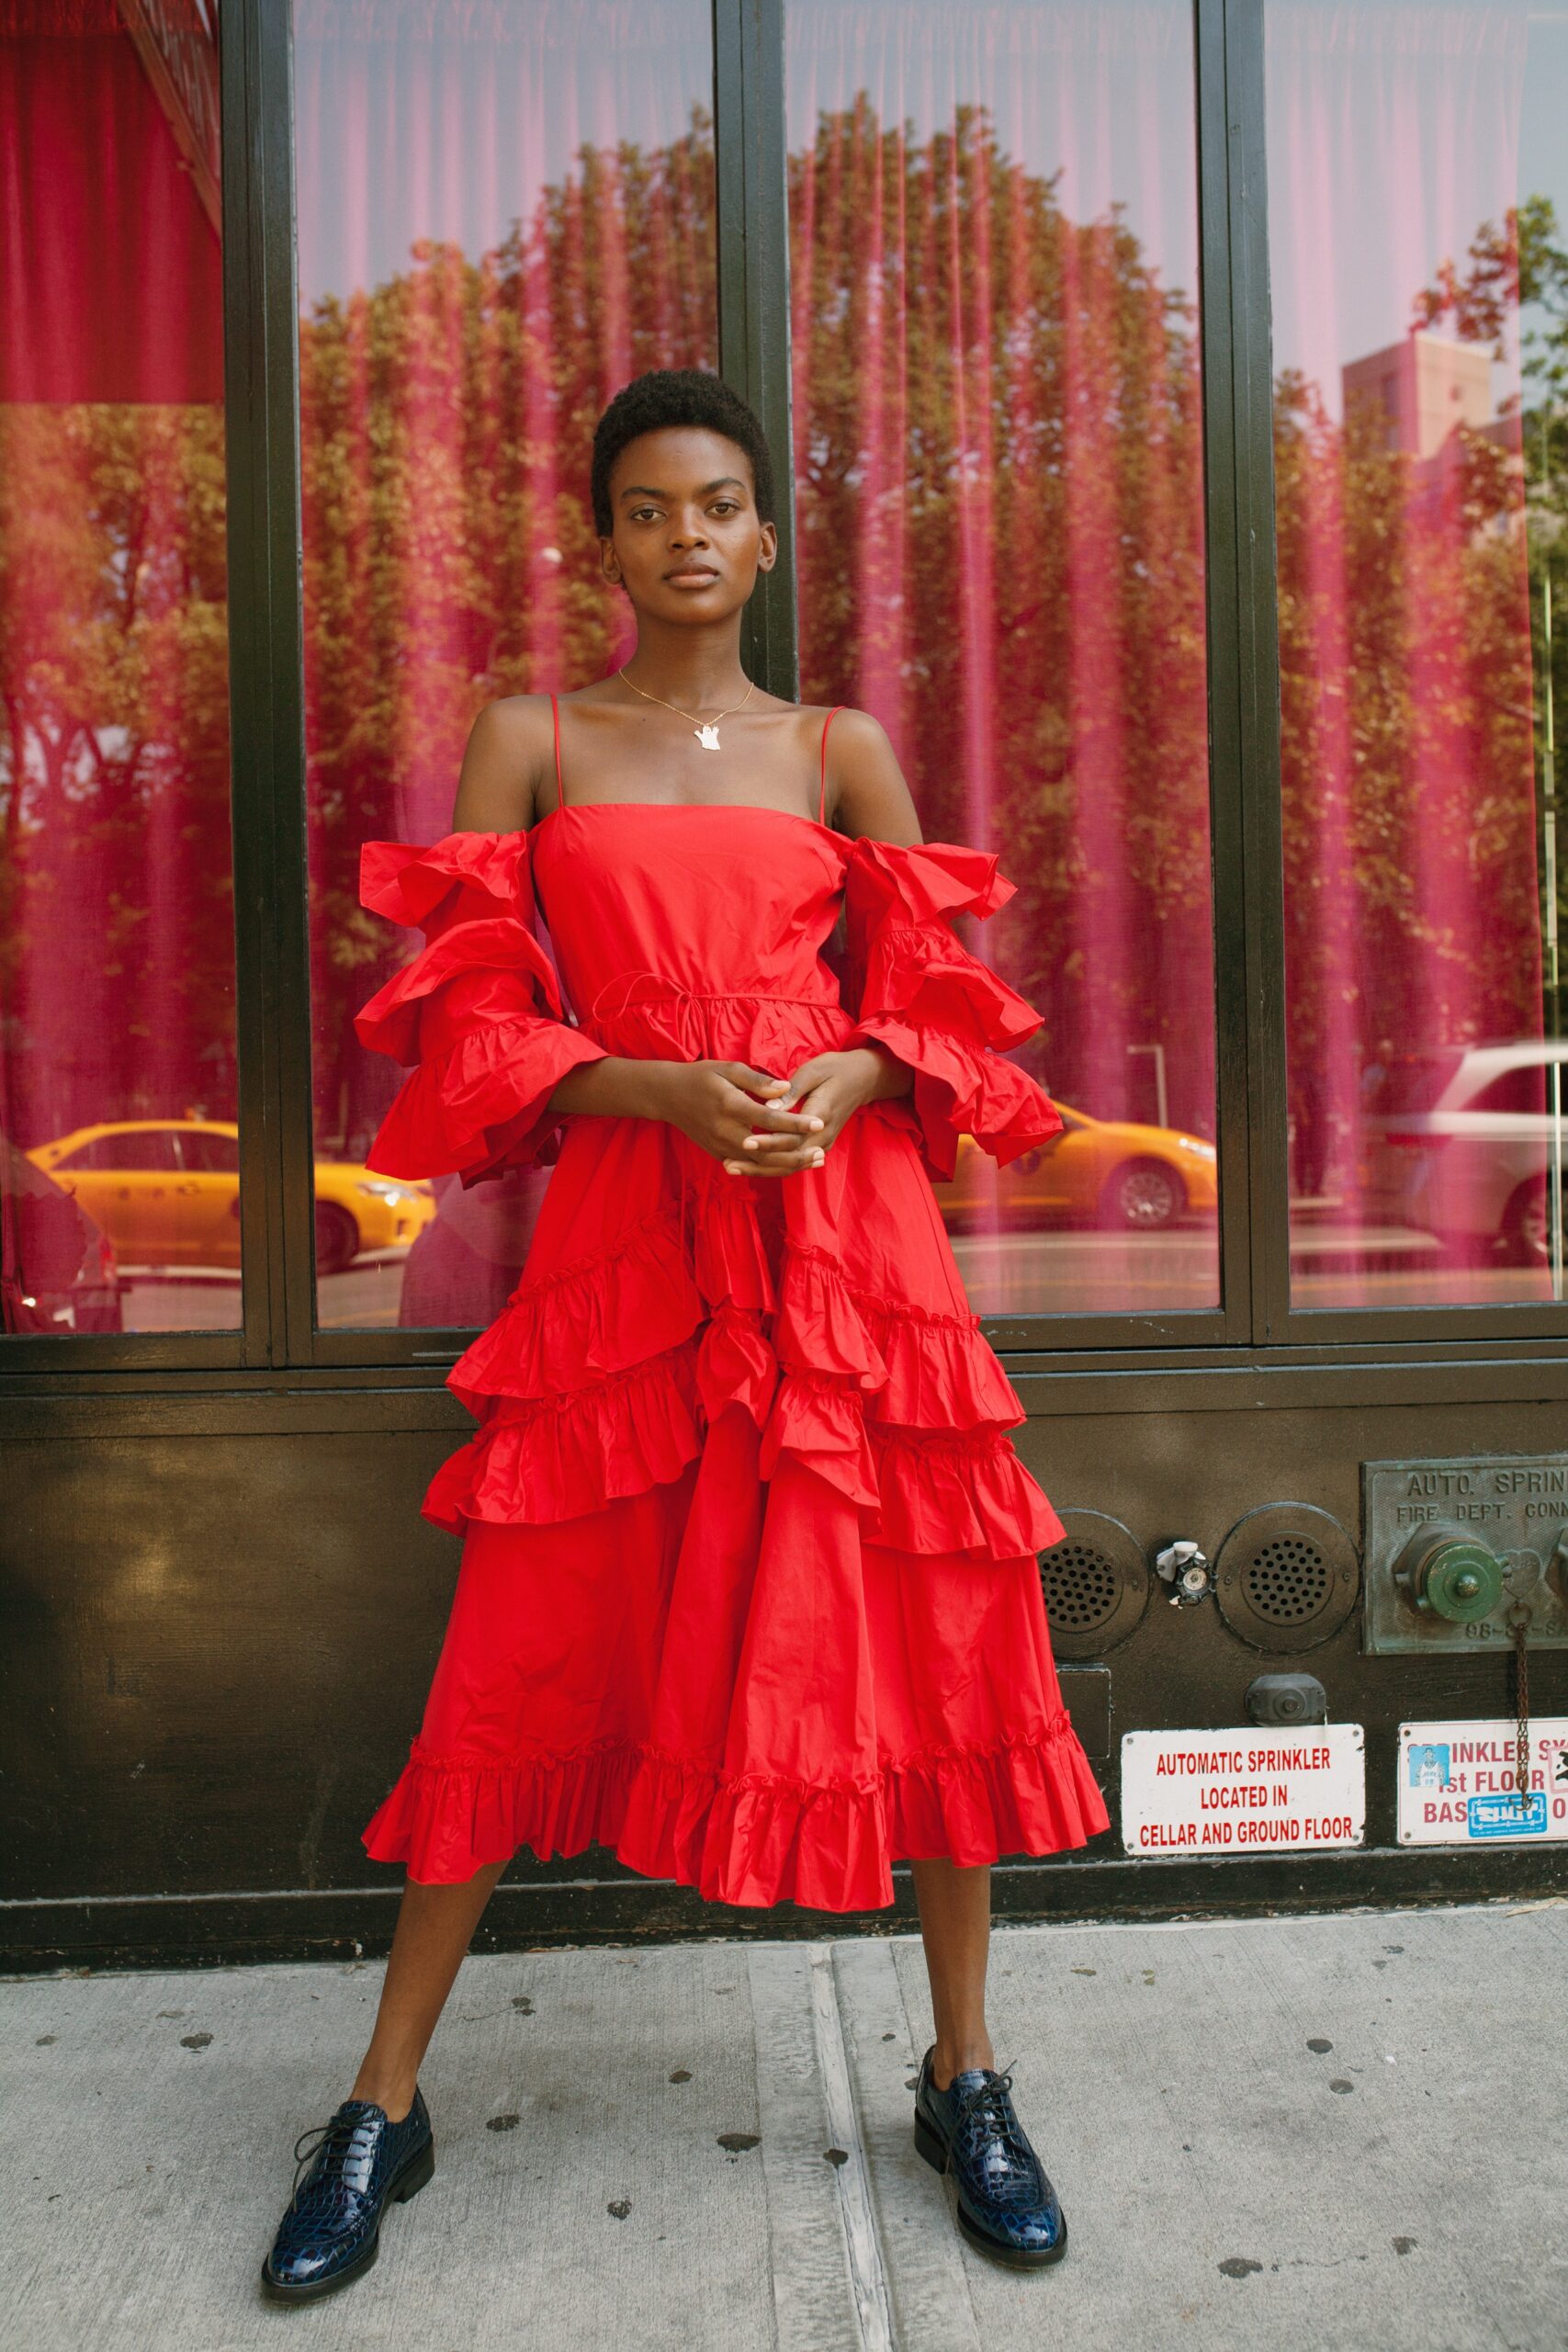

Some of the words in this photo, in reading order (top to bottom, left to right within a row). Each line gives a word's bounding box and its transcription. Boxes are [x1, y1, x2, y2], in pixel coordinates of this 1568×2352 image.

[1407, 1473, 1474, 1497] AUTO.
[1495, 1471, 1568, 1494] SPRIN
[1396, 1505, 1438, 1522] FIRE
[1456, 1504, 1511, 1521] DEPT.
[1156, 1751, 1243, 1776] AUTOMATIC
[1247, 1747, 1331, 1772] SPRINKLER
[1475, 1770, 1545, 1792] FLOR
[1201, 1785, 1268, 1810] LOCATED
[1272, 1784, 1288, 1806] IN
[1140, 1823, 1197, 1848] CELLAR
[1201, 1822, 1233, 1845] AND
[1237, 1819, 1300, 1843] GROUND
[1304, 1816, 1353, 1840] FLOOR
